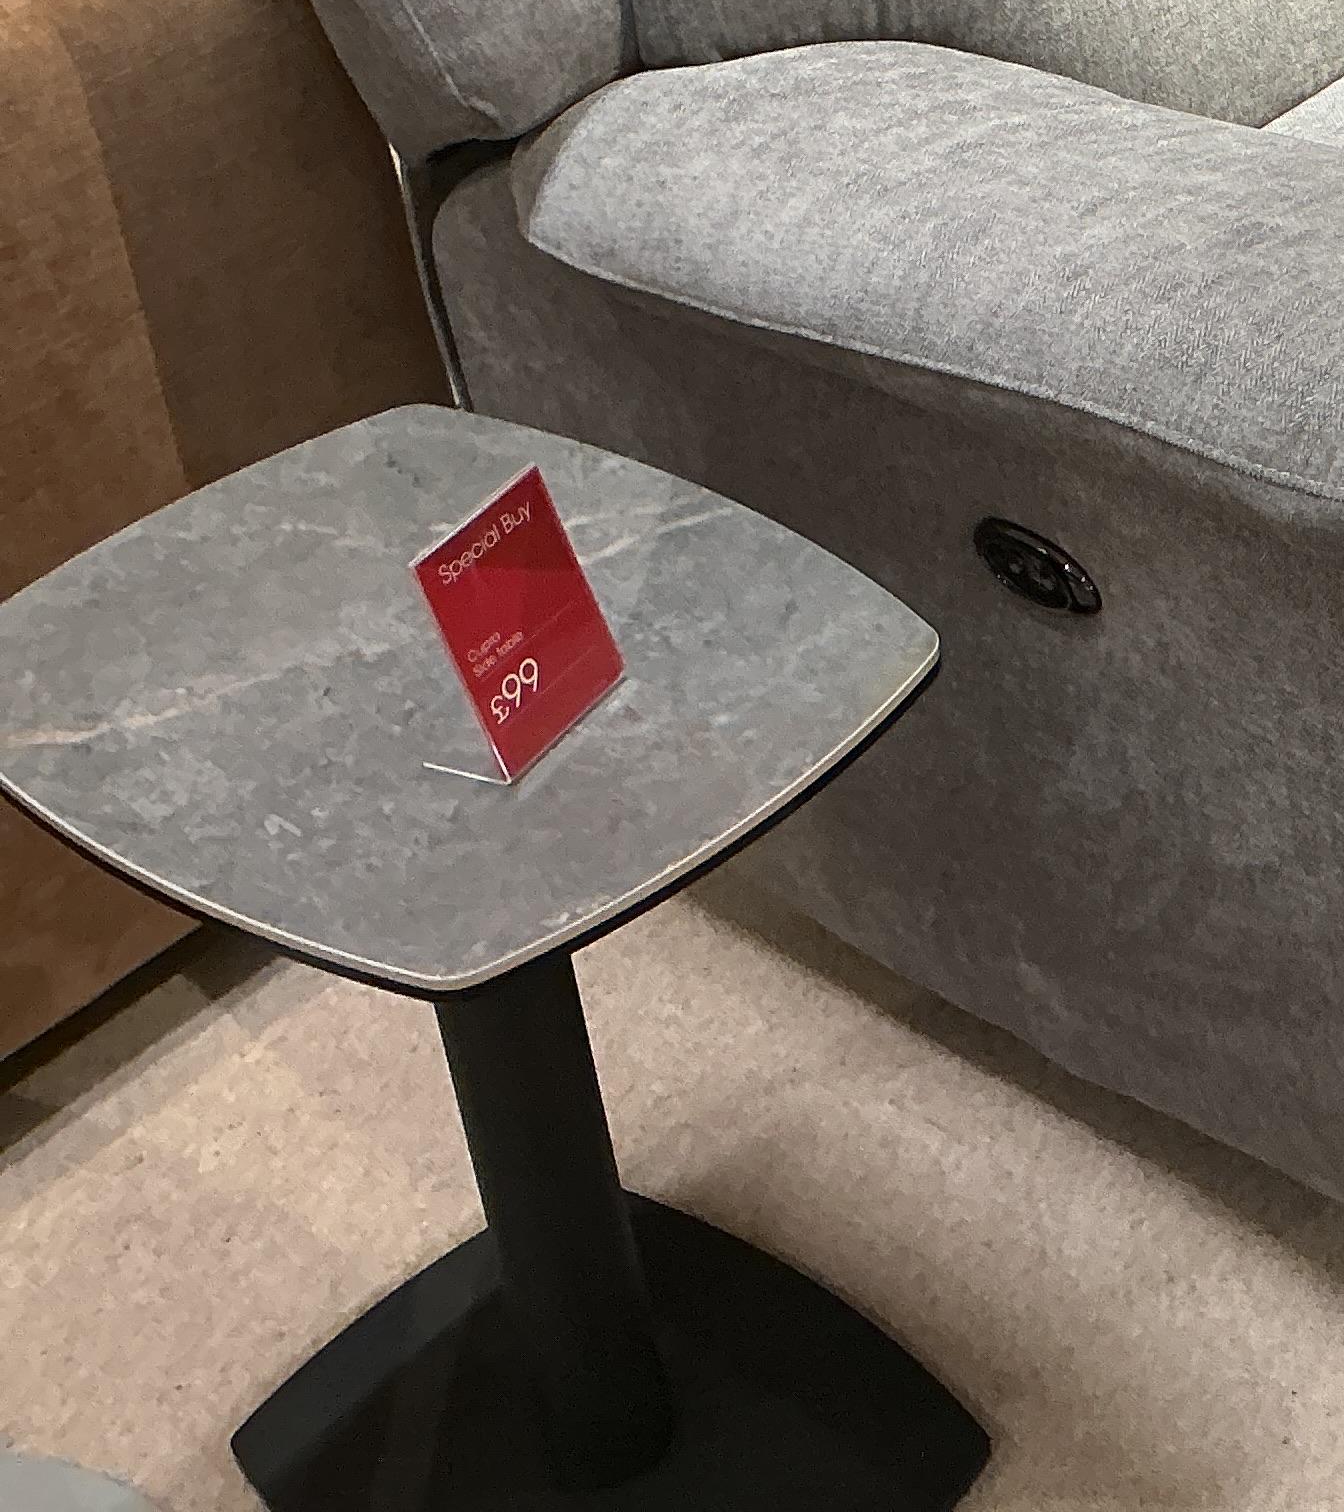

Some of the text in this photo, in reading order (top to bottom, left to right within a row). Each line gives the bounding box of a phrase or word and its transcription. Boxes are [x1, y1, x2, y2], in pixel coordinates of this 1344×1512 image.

[437, 501, 533, 586] Special Buy
[490, 657, 540, 725] £99
